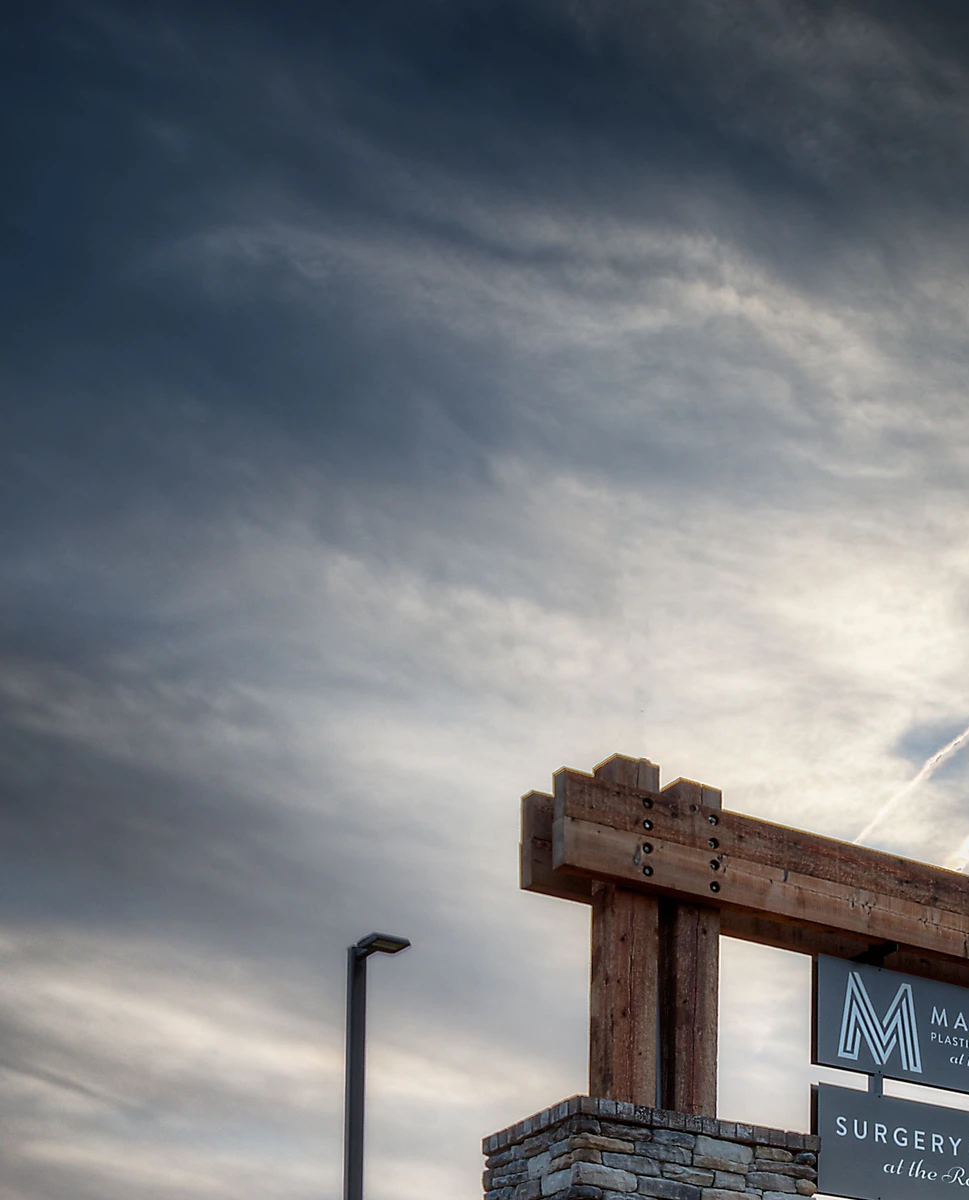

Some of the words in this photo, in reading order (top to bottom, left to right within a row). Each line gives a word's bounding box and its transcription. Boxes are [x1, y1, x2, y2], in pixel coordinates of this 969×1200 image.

[838, 971, 922, 1073] M
[949, 1054, 965, 1065] at
[836, 1117, 962, 1156] SURGERY
[883, 1159, 904, 1175] at
[907, 1159, 938, 1181] the
